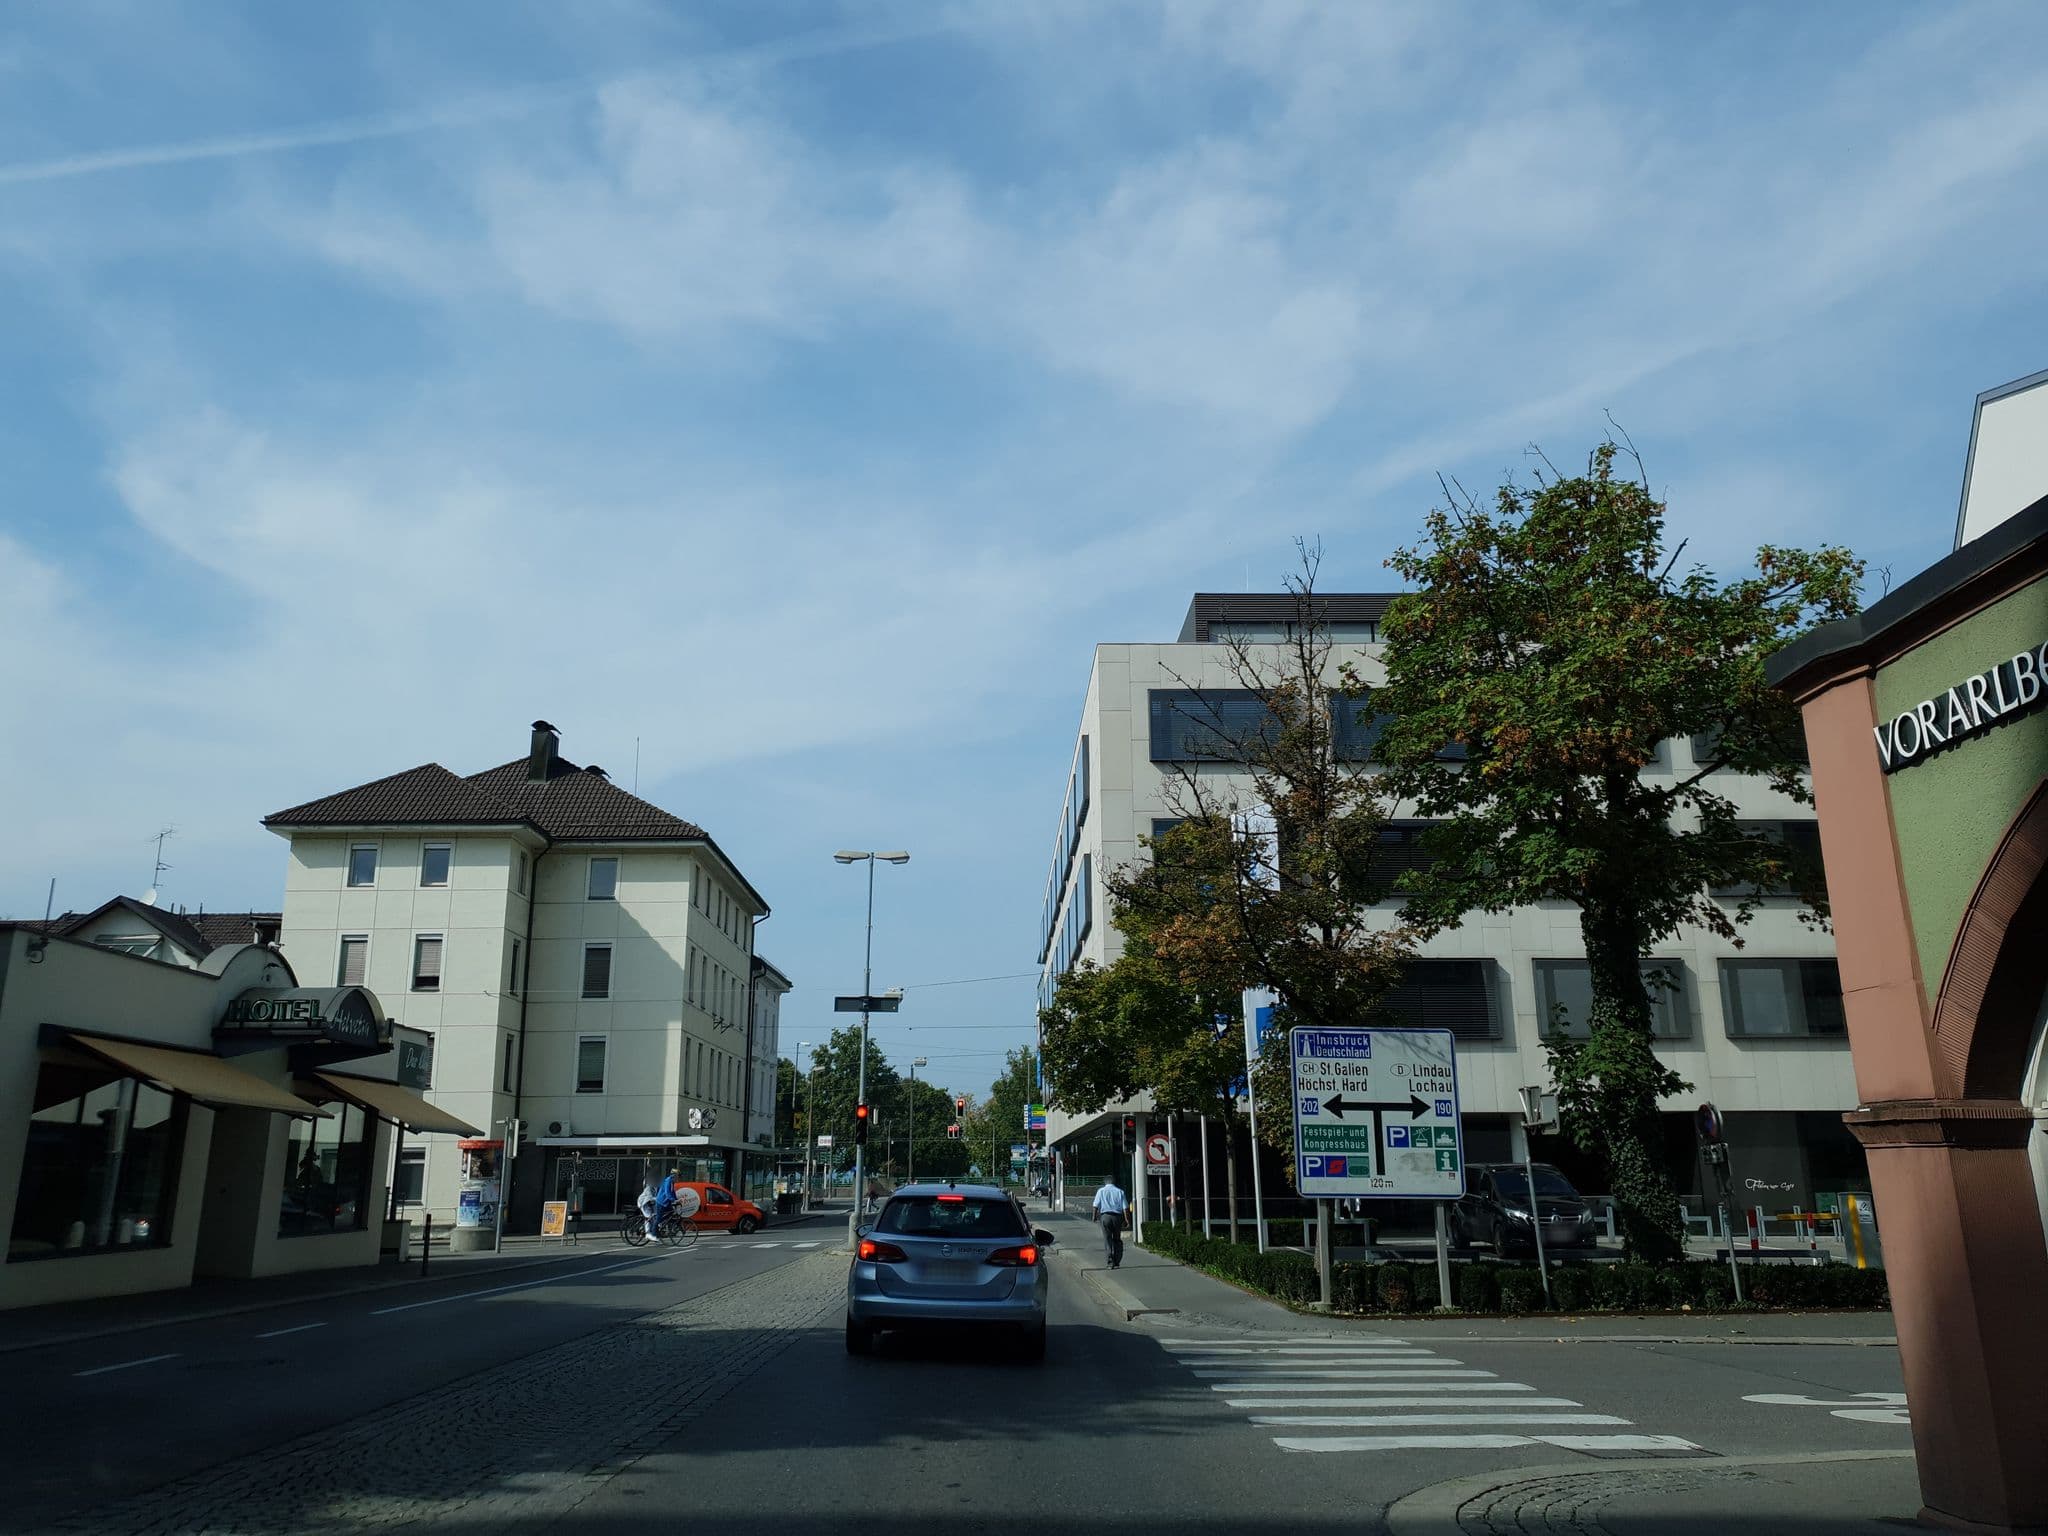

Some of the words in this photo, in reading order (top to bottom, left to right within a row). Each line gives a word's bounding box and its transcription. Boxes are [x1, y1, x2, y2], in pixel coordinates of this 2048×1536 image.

[227, 999, 327, 1022] HOTEL
[1316, 1034, 1369, 1046] Innsbruck
[1316, 1045, 1370, 1058] Deutschland
[1302, 1063, 1315, 1073] CH
[1413, 1064, 1452, 1078] Lindau
[1342, 1077, 1368, 1092] Hard
[1409, 1078, 1453, 1093] Lochau
[1302, 1100, 1318, 1113] 202
[1436, 1101, 1452, 1115] 190
[1390, 1127, 1405, 1146] P
[1304, 1138, 1366, 1151] Kongresshaus
[1305, 1156, 1321, 1176] P
[1370, 1178, 1384, 1188] 120
